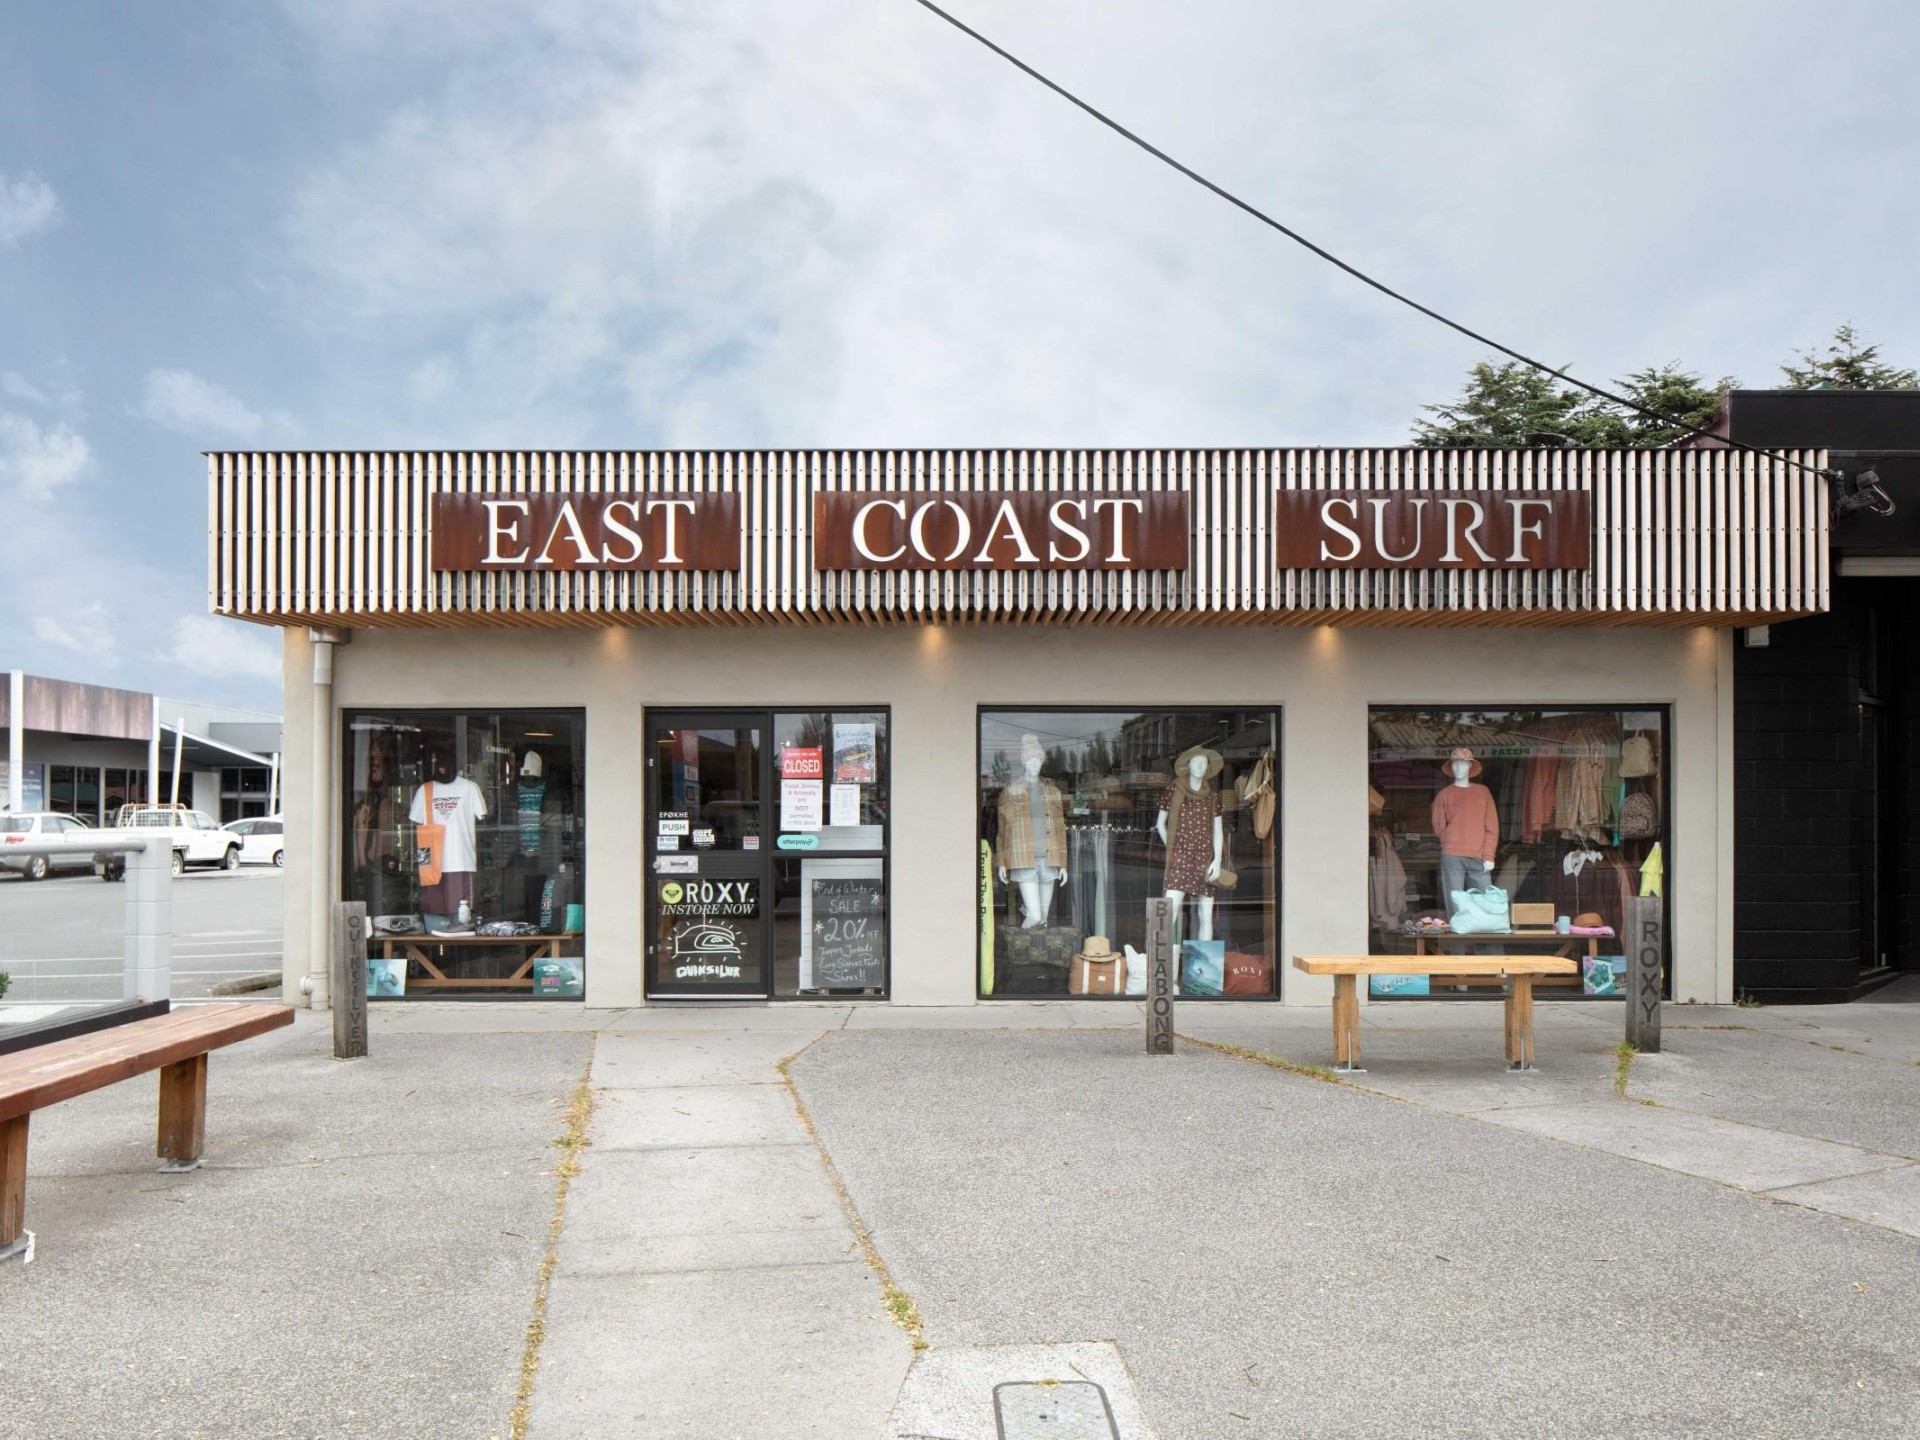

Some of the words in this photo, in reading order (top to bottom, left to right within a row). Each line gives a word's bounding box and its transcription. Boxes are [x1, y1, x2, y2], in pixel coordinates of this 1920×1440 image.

[481, 500, 695, 563] EAST
[852, 499, 1143, 562] COAST
[1320, 499, 1553, 562] SURF
[784, 760, 820, 773] CLOSED
[662, 823, 686, 832] PUSH
[782, 838, 806, 846] afterpay
[844, 880, 875, 895] Winter
[661, 903, 720, 915] INSTORE
[721, 903, 755, 915] NOW
[829, 899, 861, 914] SALE
[823, 917, 868, 942] 20%
[866, 929, 880, 940] OFF
[1639, 921, 1660, 1013] ROXY
[1153, 901, 1170, 1051] BILLABONG
[348, 915, 362, 1055] QUIKSILVER
